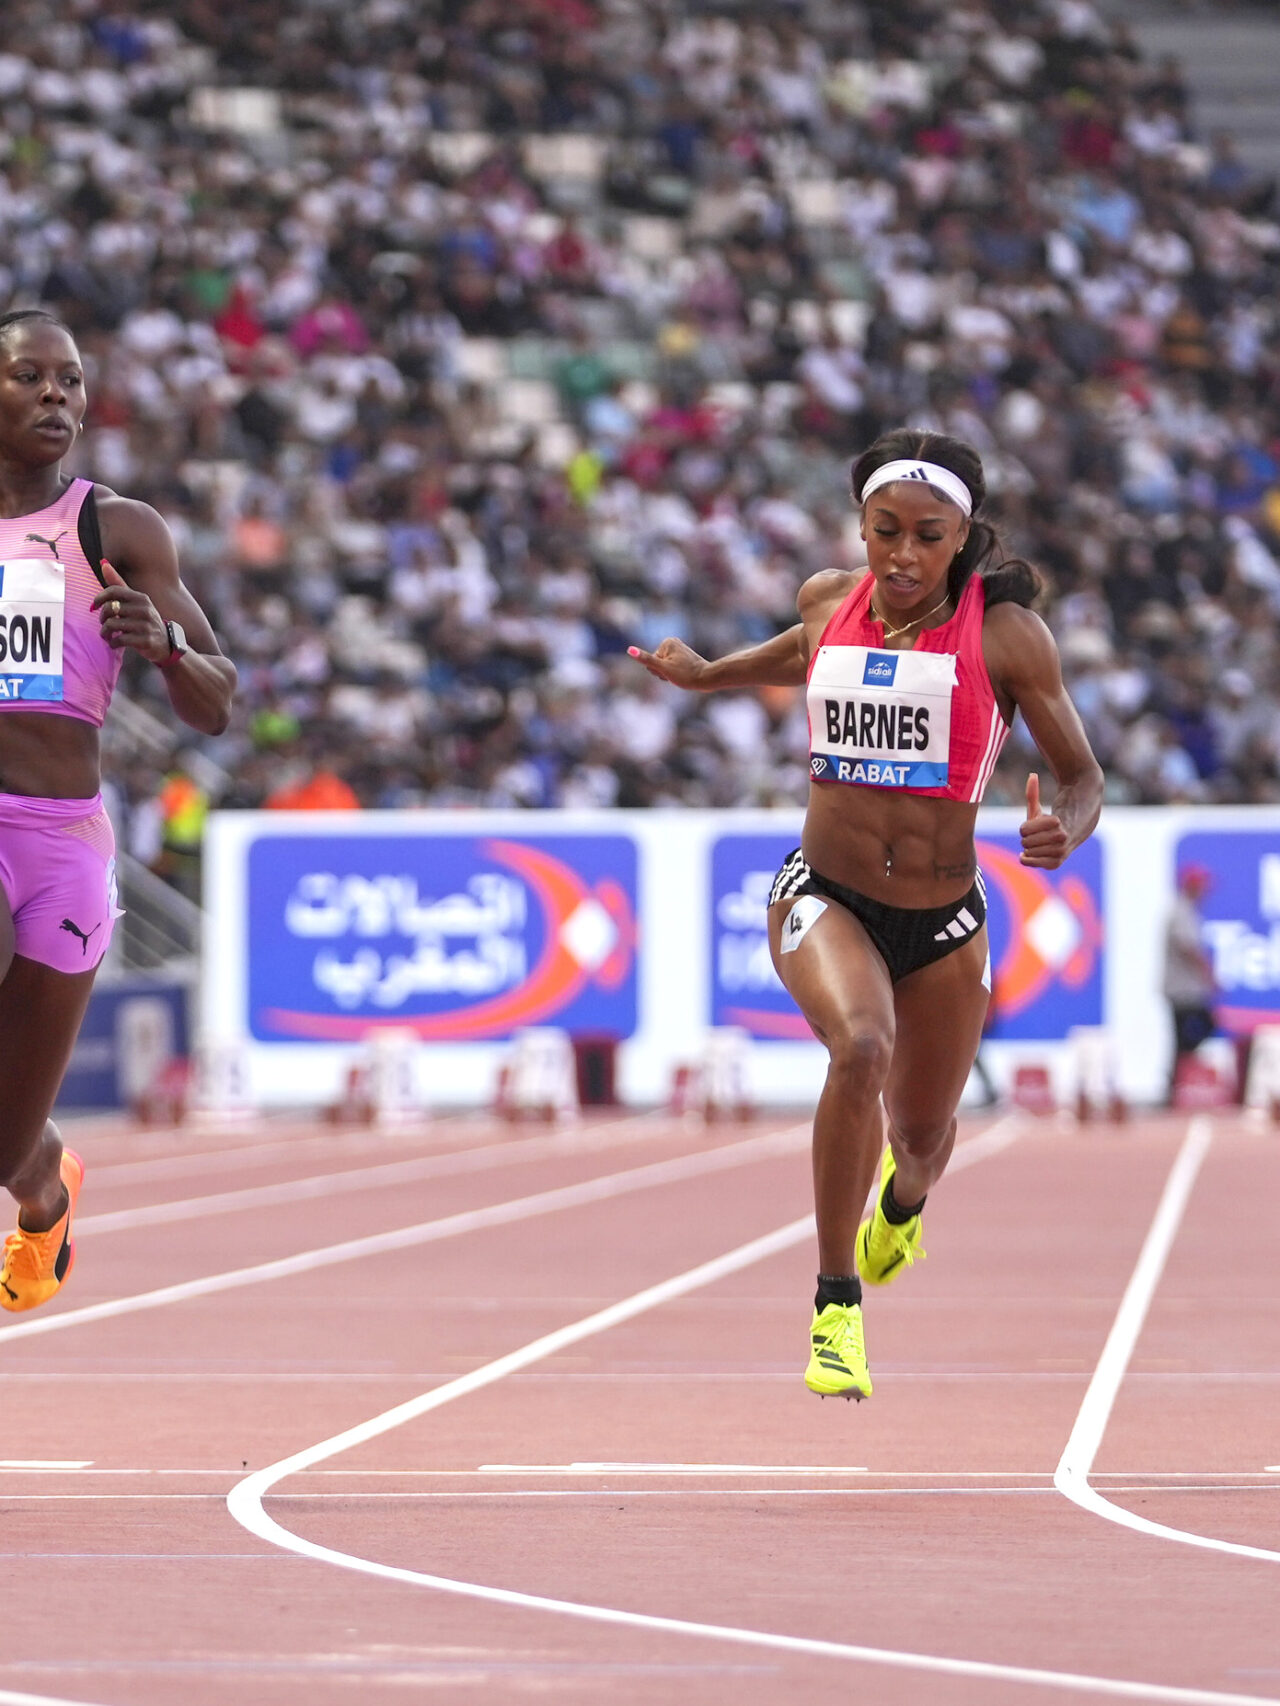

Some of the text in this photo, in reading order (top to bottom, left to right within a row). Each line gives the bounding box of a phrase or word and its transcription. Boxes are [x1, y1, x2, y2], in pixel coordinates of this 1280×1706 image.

[825, 699, 929, 751] BARNES
[838, 761, 911, 784] RABAT
[790, 912, 803, 936] 4
